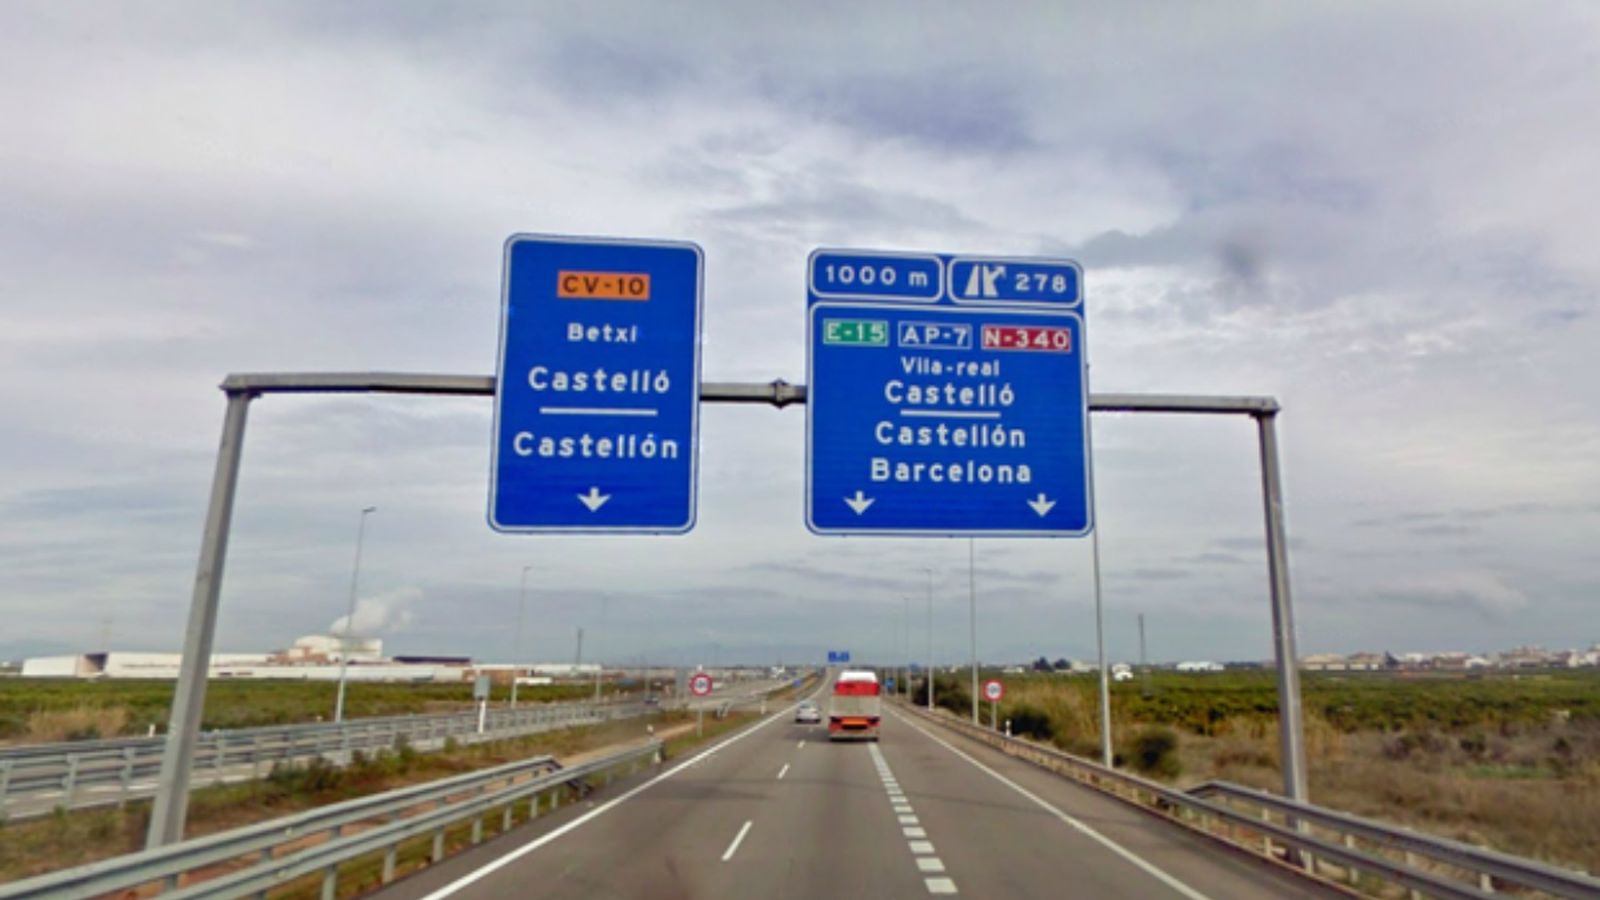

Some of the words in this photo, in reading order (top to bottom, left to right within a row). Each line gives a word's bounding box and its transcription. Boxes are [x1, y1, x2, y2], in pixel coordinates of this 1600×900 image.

[562, 274, 645, 295] CV-10
[825, 265, 896, 285] 1000
[908, 271, 928, 286] m
[1015, 273, 1067, 293] 278
[826, 321, 885, 342] E-15
[902, 325, 968, 345] AP-7
[984, 328, 1069, 349] N-340
[900, 356, 1000, 376] Vila-real
[528, 366, 671, 393] Castelló
[884, 380, 1015, 406] Castelló
[513, 431, 679, 458] Castellón
[874, 421, 1026, 447] Castellón
[871, 458, 1031, 483] Barcelona
